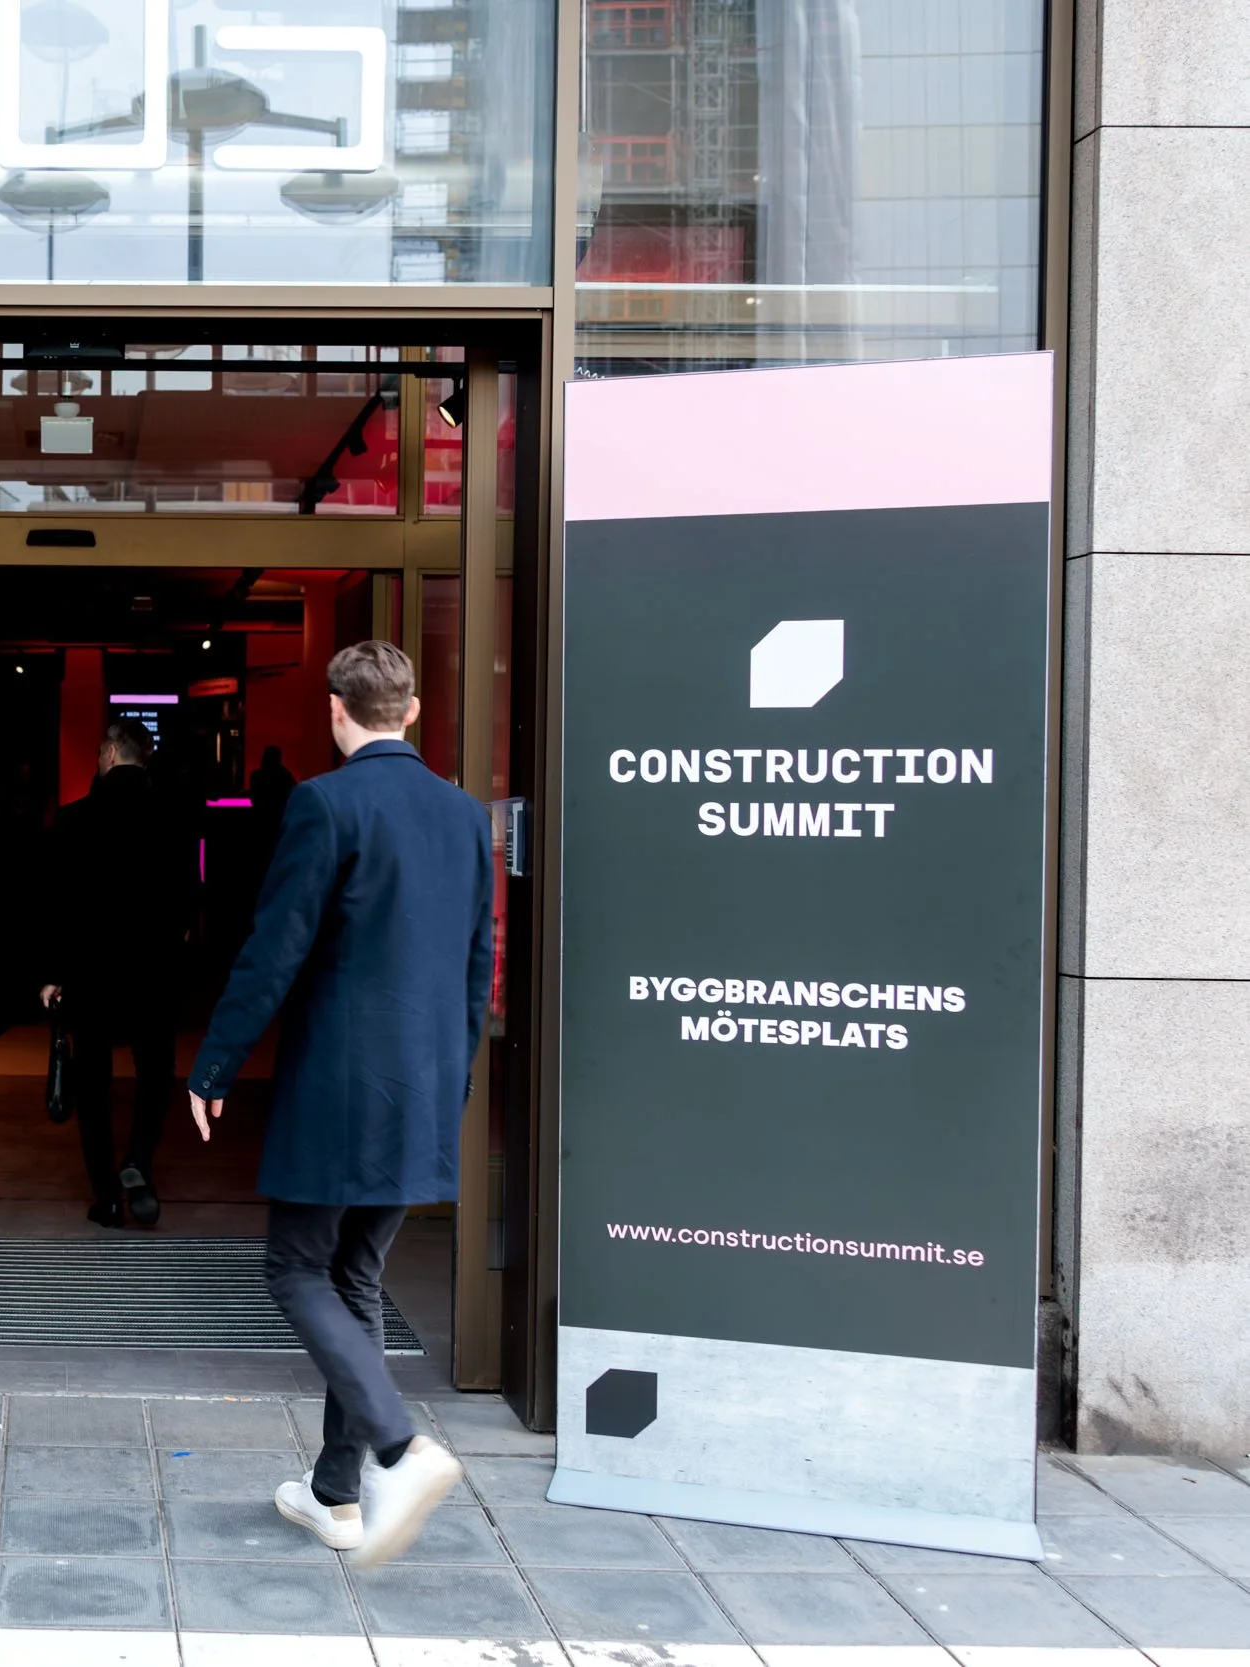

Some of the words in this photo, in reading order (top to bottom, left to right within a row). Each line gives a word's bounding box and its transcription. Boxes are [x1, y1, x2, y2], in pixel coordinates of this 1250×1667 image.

[609, 748, 993, 784] CONSTRUCTION
[697, 801, 895, 838] SUMMIT
[629, 975, 966, 1013] BYGGBRANSCHENS
[681, 1009, 909, 1050] MÖTESPLATS
[606, 1223, 985, 1267] www.constructionsummit.se
